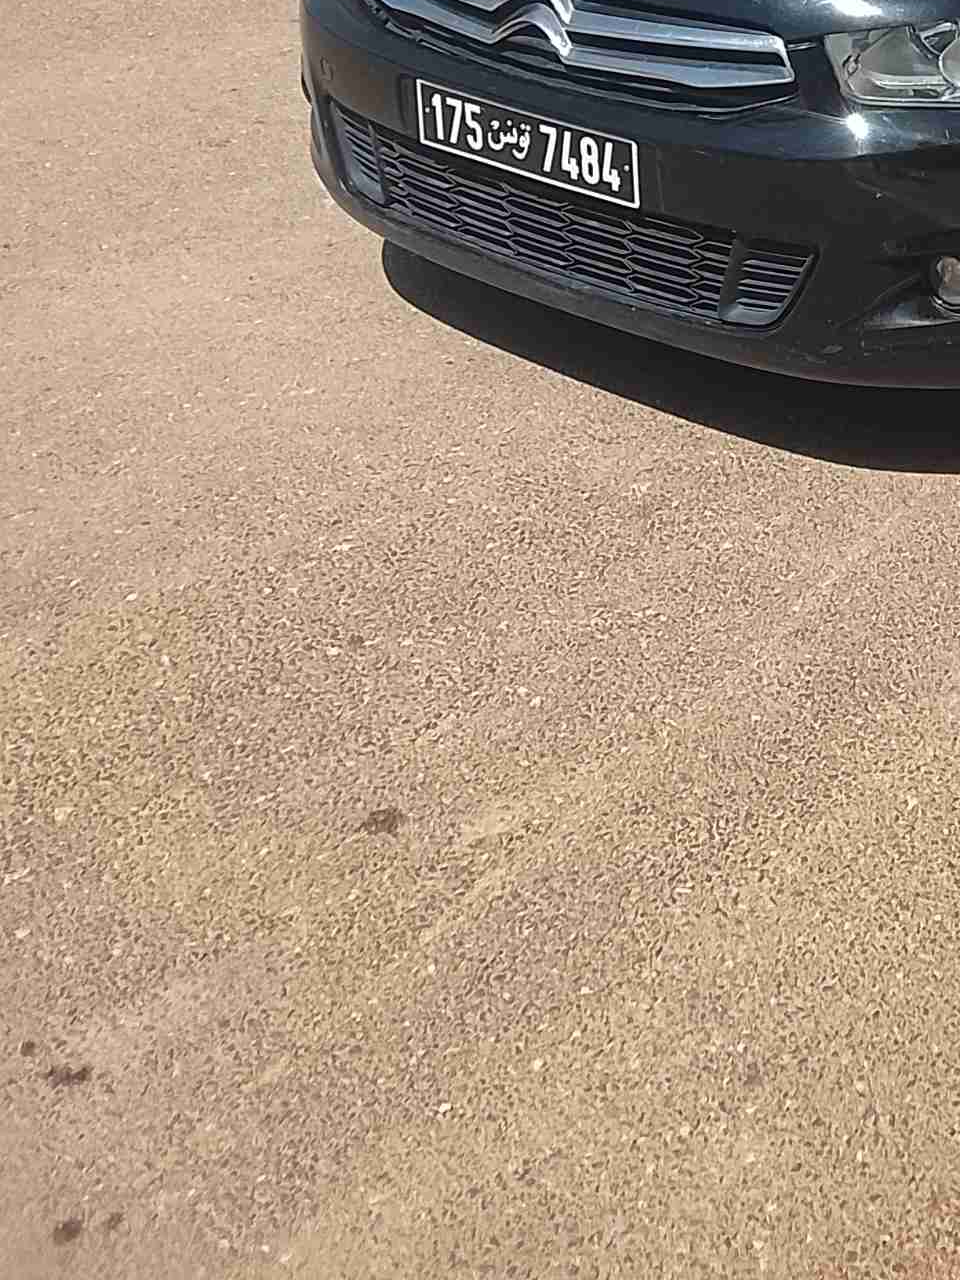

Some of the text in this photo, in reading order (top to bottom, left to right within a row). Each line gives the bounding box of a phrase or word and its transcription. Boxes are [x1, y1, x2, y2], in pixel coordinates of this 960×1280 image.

[431, 93, 621, 192] 175 تونس 7484
